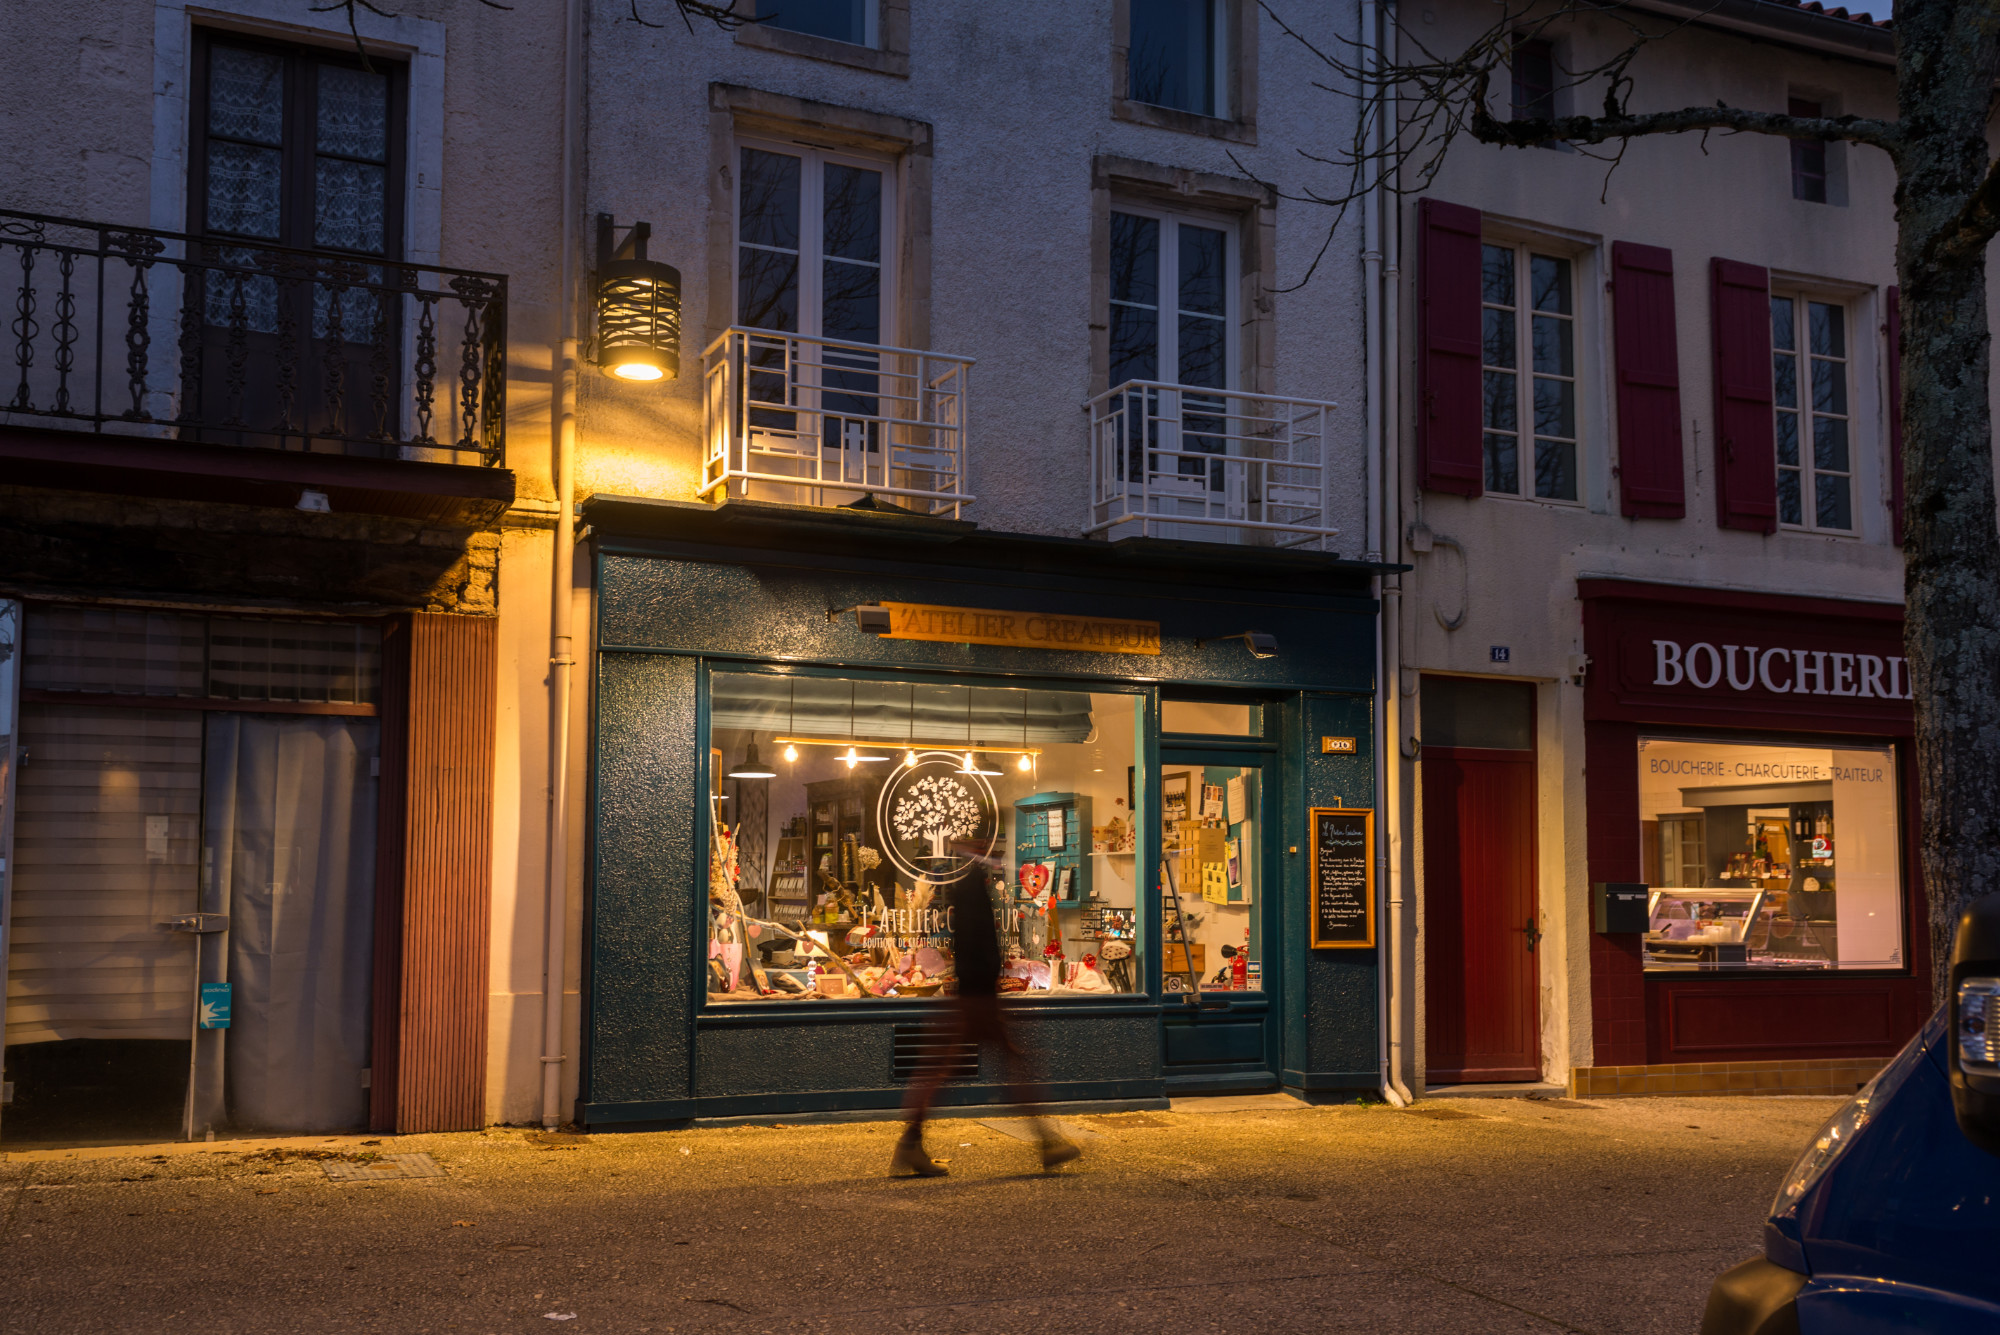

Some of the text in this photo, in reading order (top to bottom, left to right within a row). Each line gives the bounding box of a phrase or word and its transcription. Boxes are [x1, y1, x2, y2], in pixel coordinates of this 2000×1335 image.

[1025, 616, 1160, 649] CREATEUR
[1495, 648, 1506, 660] 14
[1650, 758, 1725, 777] BOUCHERIE
[1735, 762, 1820, 780] CHARCUTERIE
[1830, 766, 1884, 783] TRAITEUR
[947, 905, 1020, 934] CEUR
